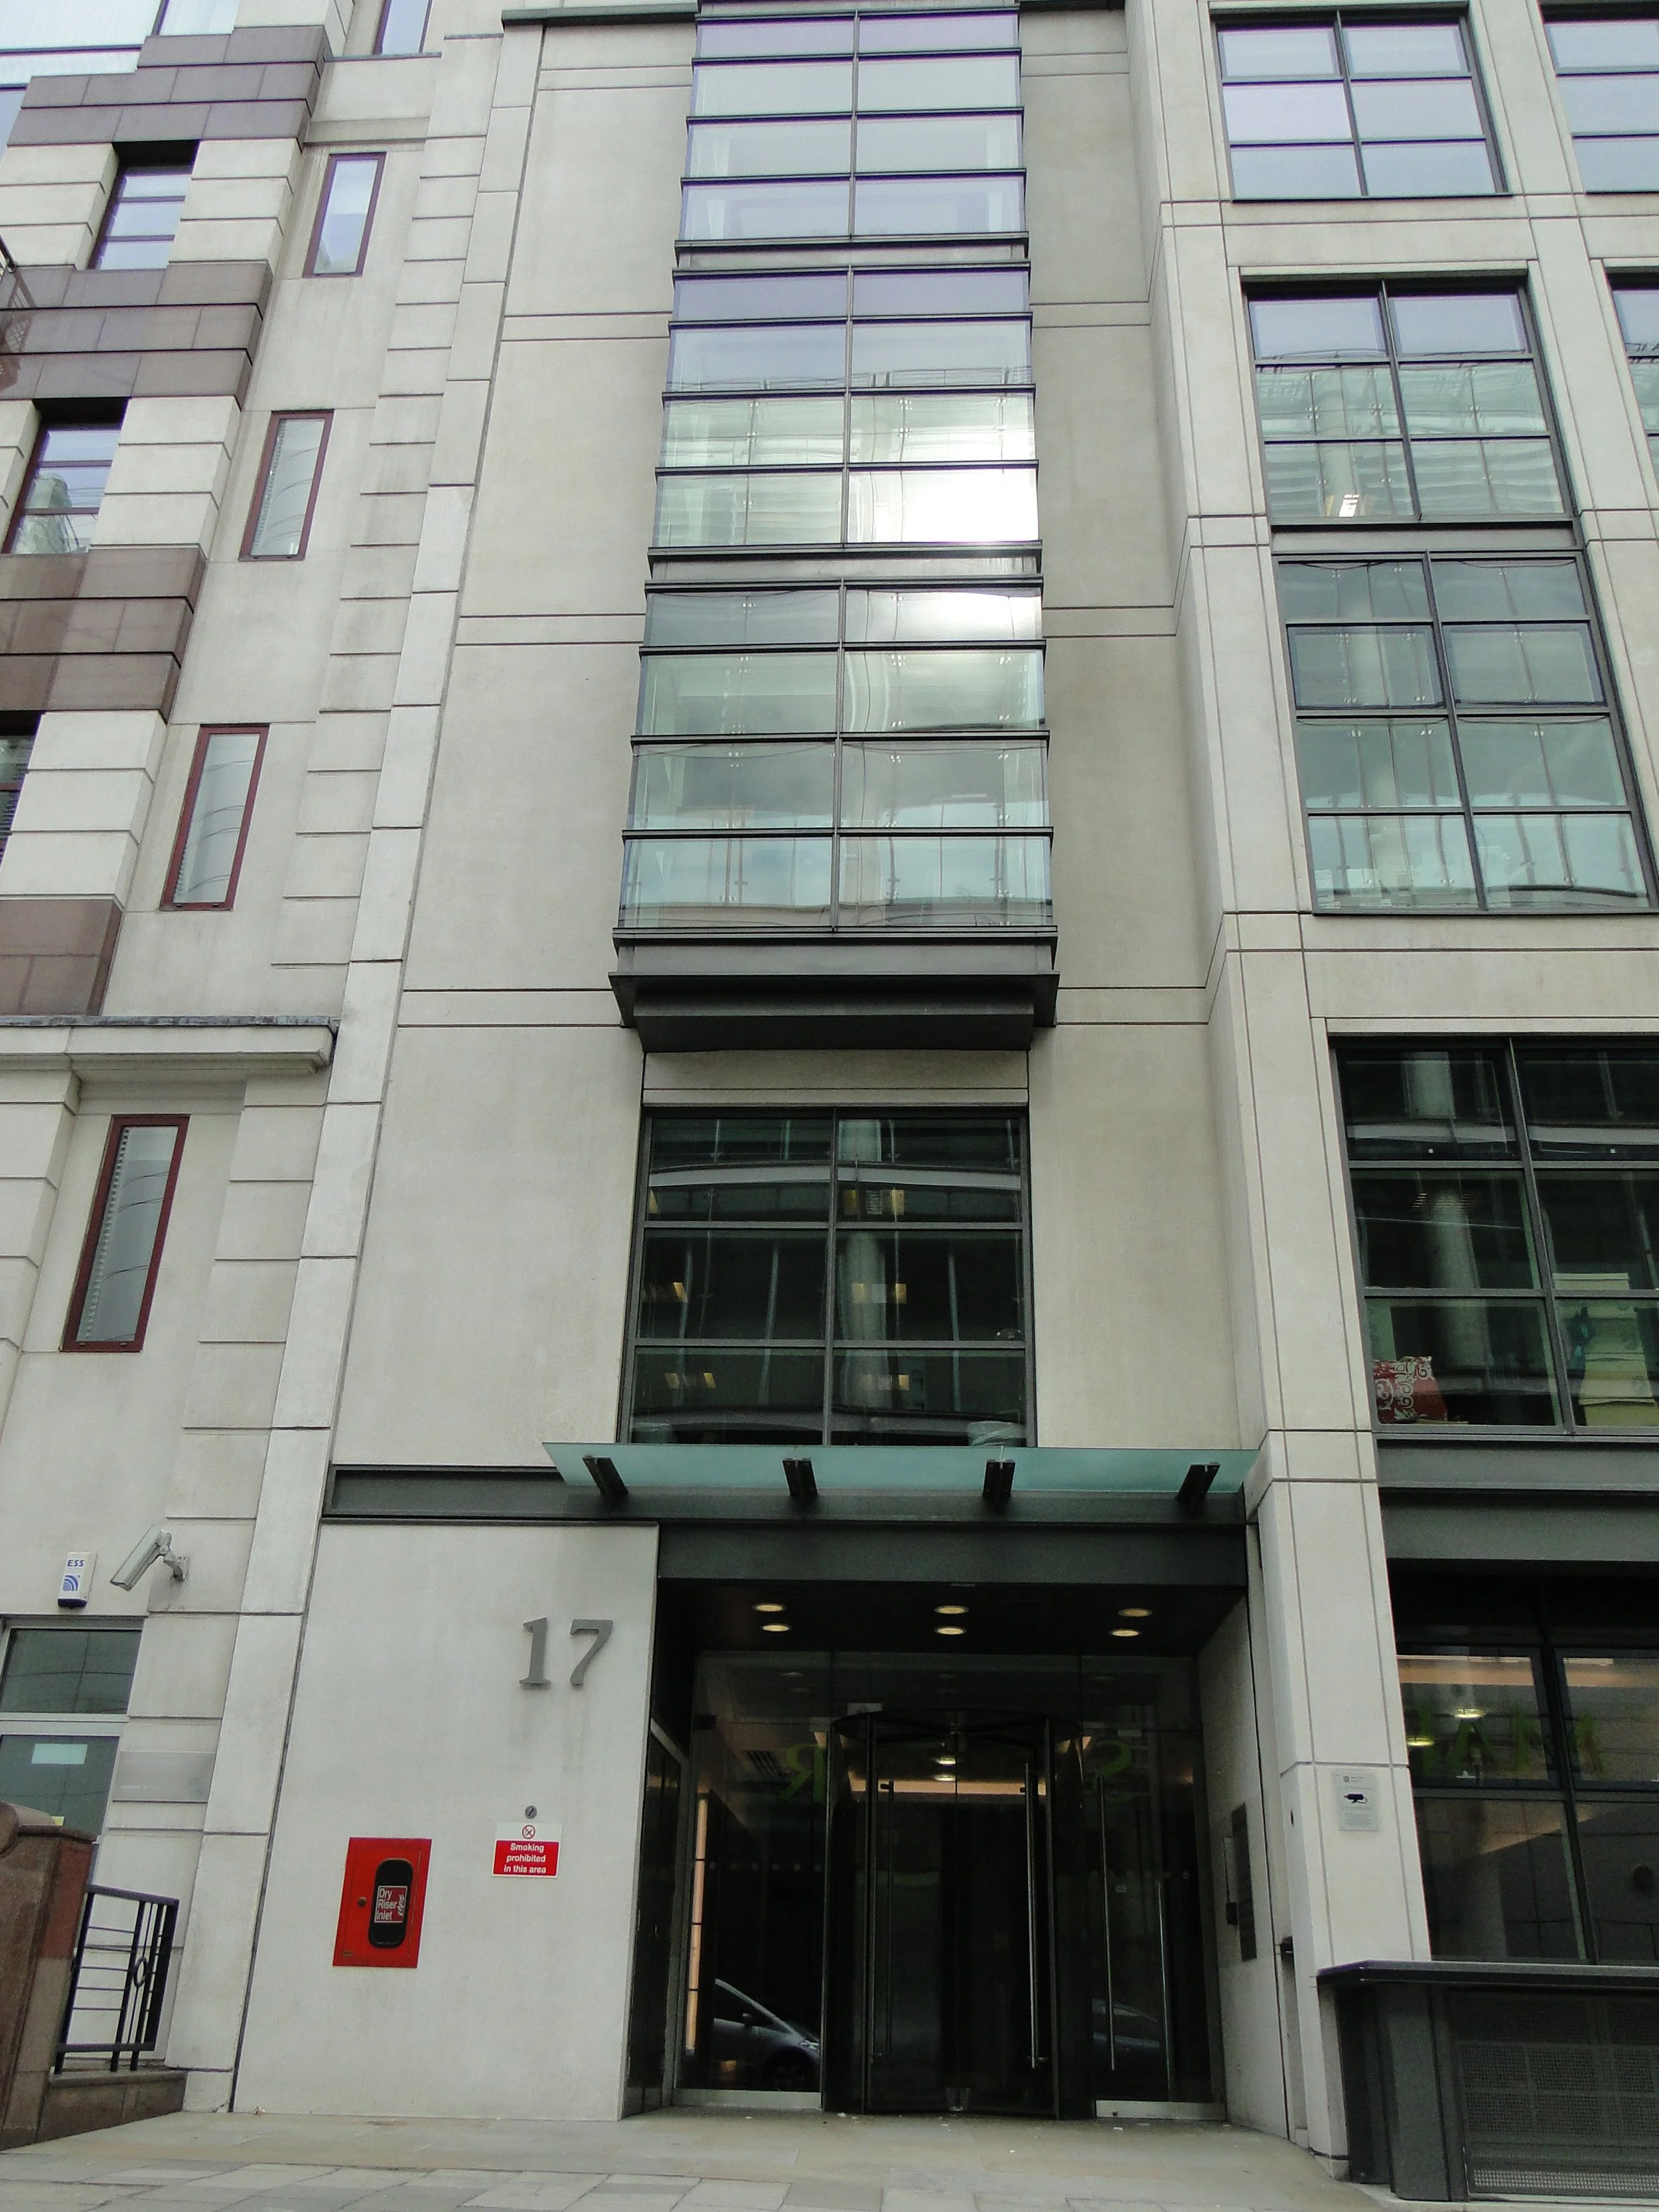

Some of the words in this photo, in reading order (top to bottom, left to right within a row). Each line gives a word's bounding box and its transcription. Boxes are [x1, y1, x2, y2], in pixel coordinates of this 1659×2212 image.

[519, 1617, 614, 1685] 17
[510, 1843, 544, 1853] Smoking
[506, 1854, 546, 1863] prohibited
[504, 1864, 512, 1872] in
[513, 1864, 528, 1873] this
[379, 1888, 392, 1900] Dry
[378, 1899, 397, 1909] Riser
[376, 1910, 392, 1920] Inlet
